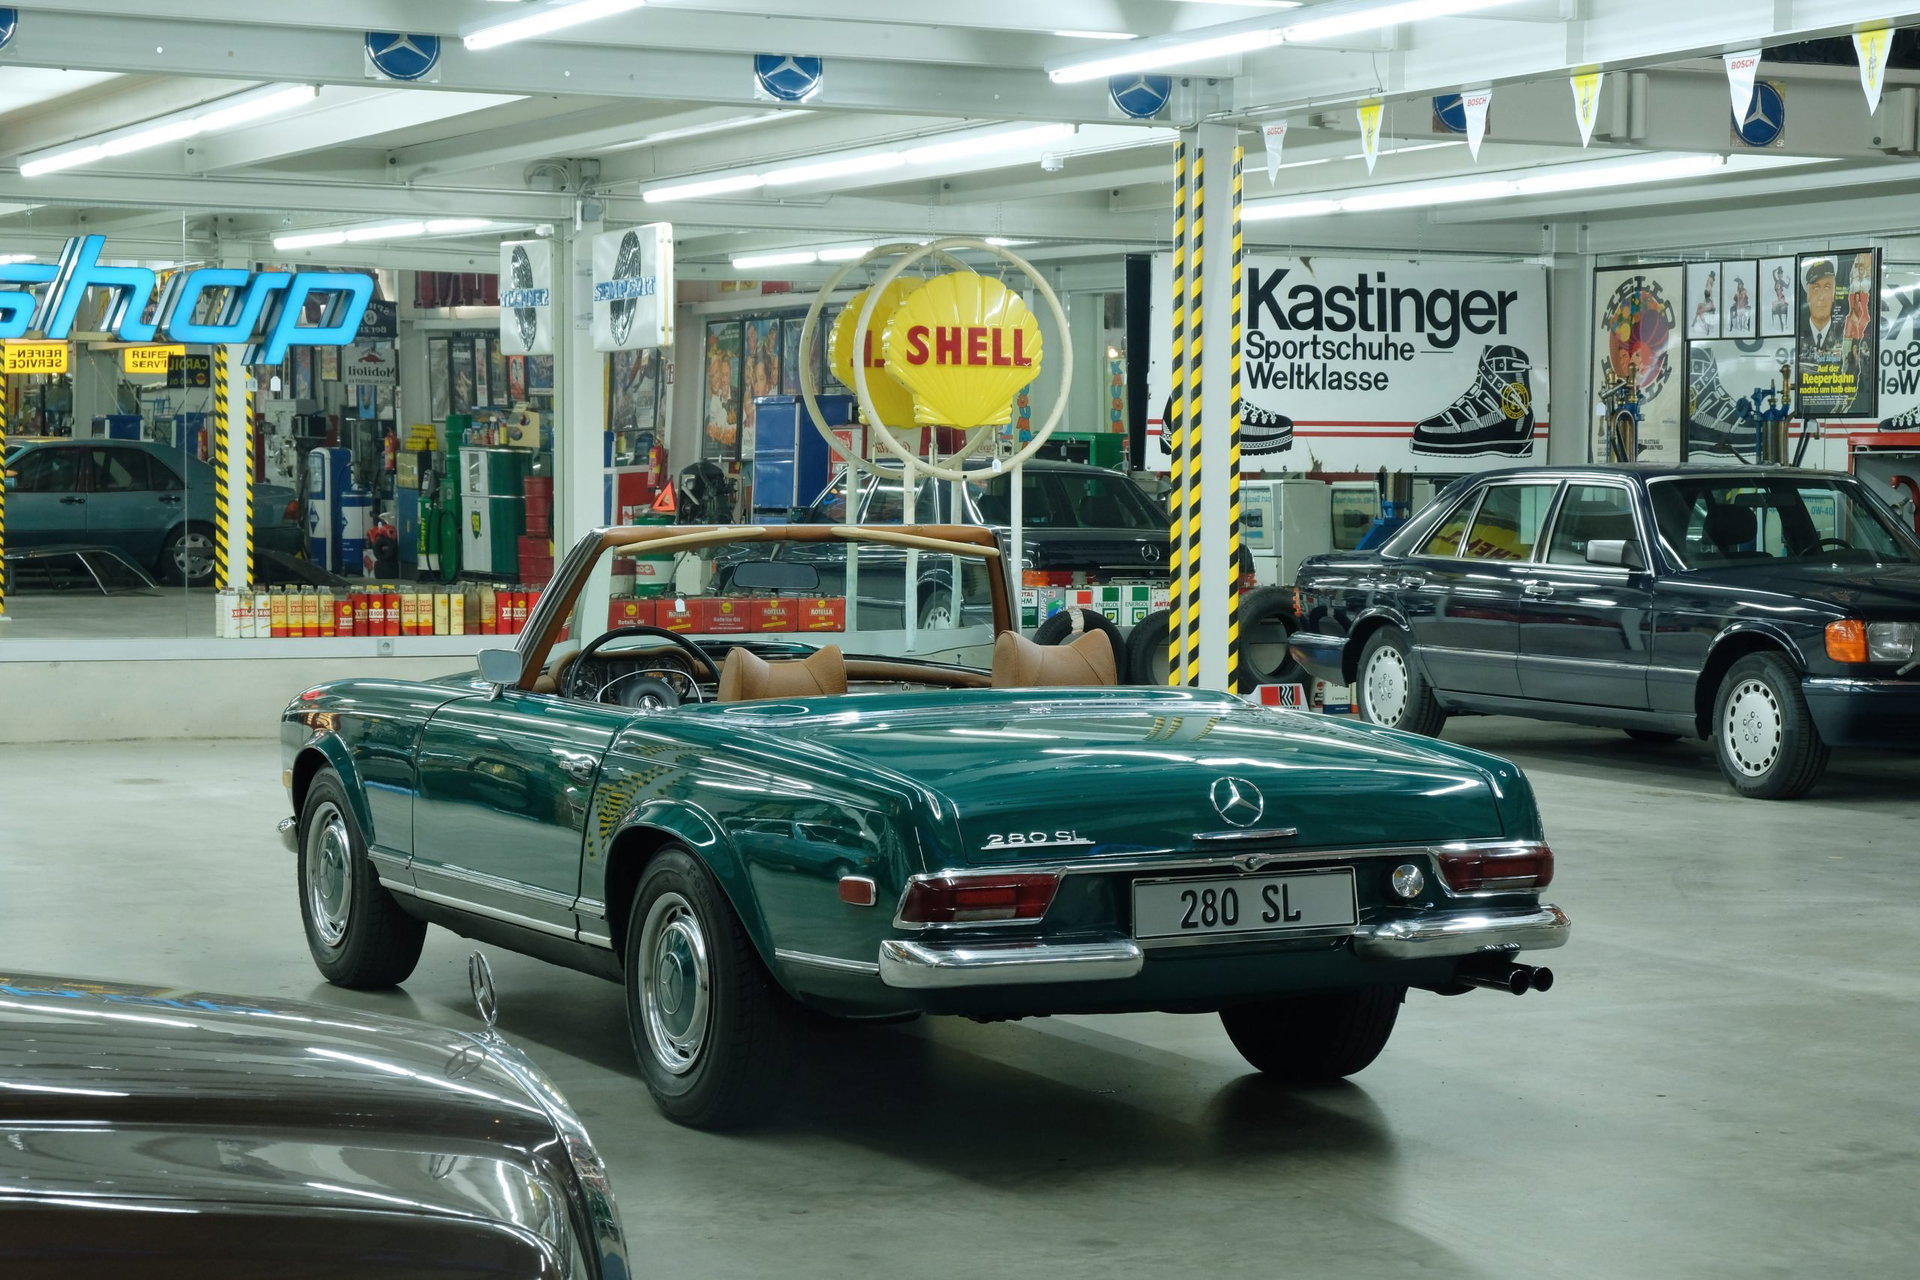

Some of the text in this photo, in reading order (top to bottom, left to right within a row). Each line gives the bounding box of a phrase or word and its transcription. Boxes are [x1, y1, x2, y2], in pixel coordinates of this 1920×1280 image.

[1731, 58, 1755, 70] BOSCH
[1467, 97, 1488, 107] BOSCH
[1267, 127, 1284, 136] BOSCH
[594, 276, 656, 302] SEMPERIT
[1247, 267, 1518, 349] Kastinger
[906, 325, 1032, 368] SHELL
[1245, 330, 1415, 364] Sportschuhe
[1246, 361, 1389, 391] Weltklasse
[1817, 364, 1840, 373] Auf der
[1803, 373, 1854, 387] Reeperbahn
[1800, 386, 1819, 394] nachts
[986, 829, 1082, 846] 280 SL
[1180, 883, 1301, 929] 280 SL
